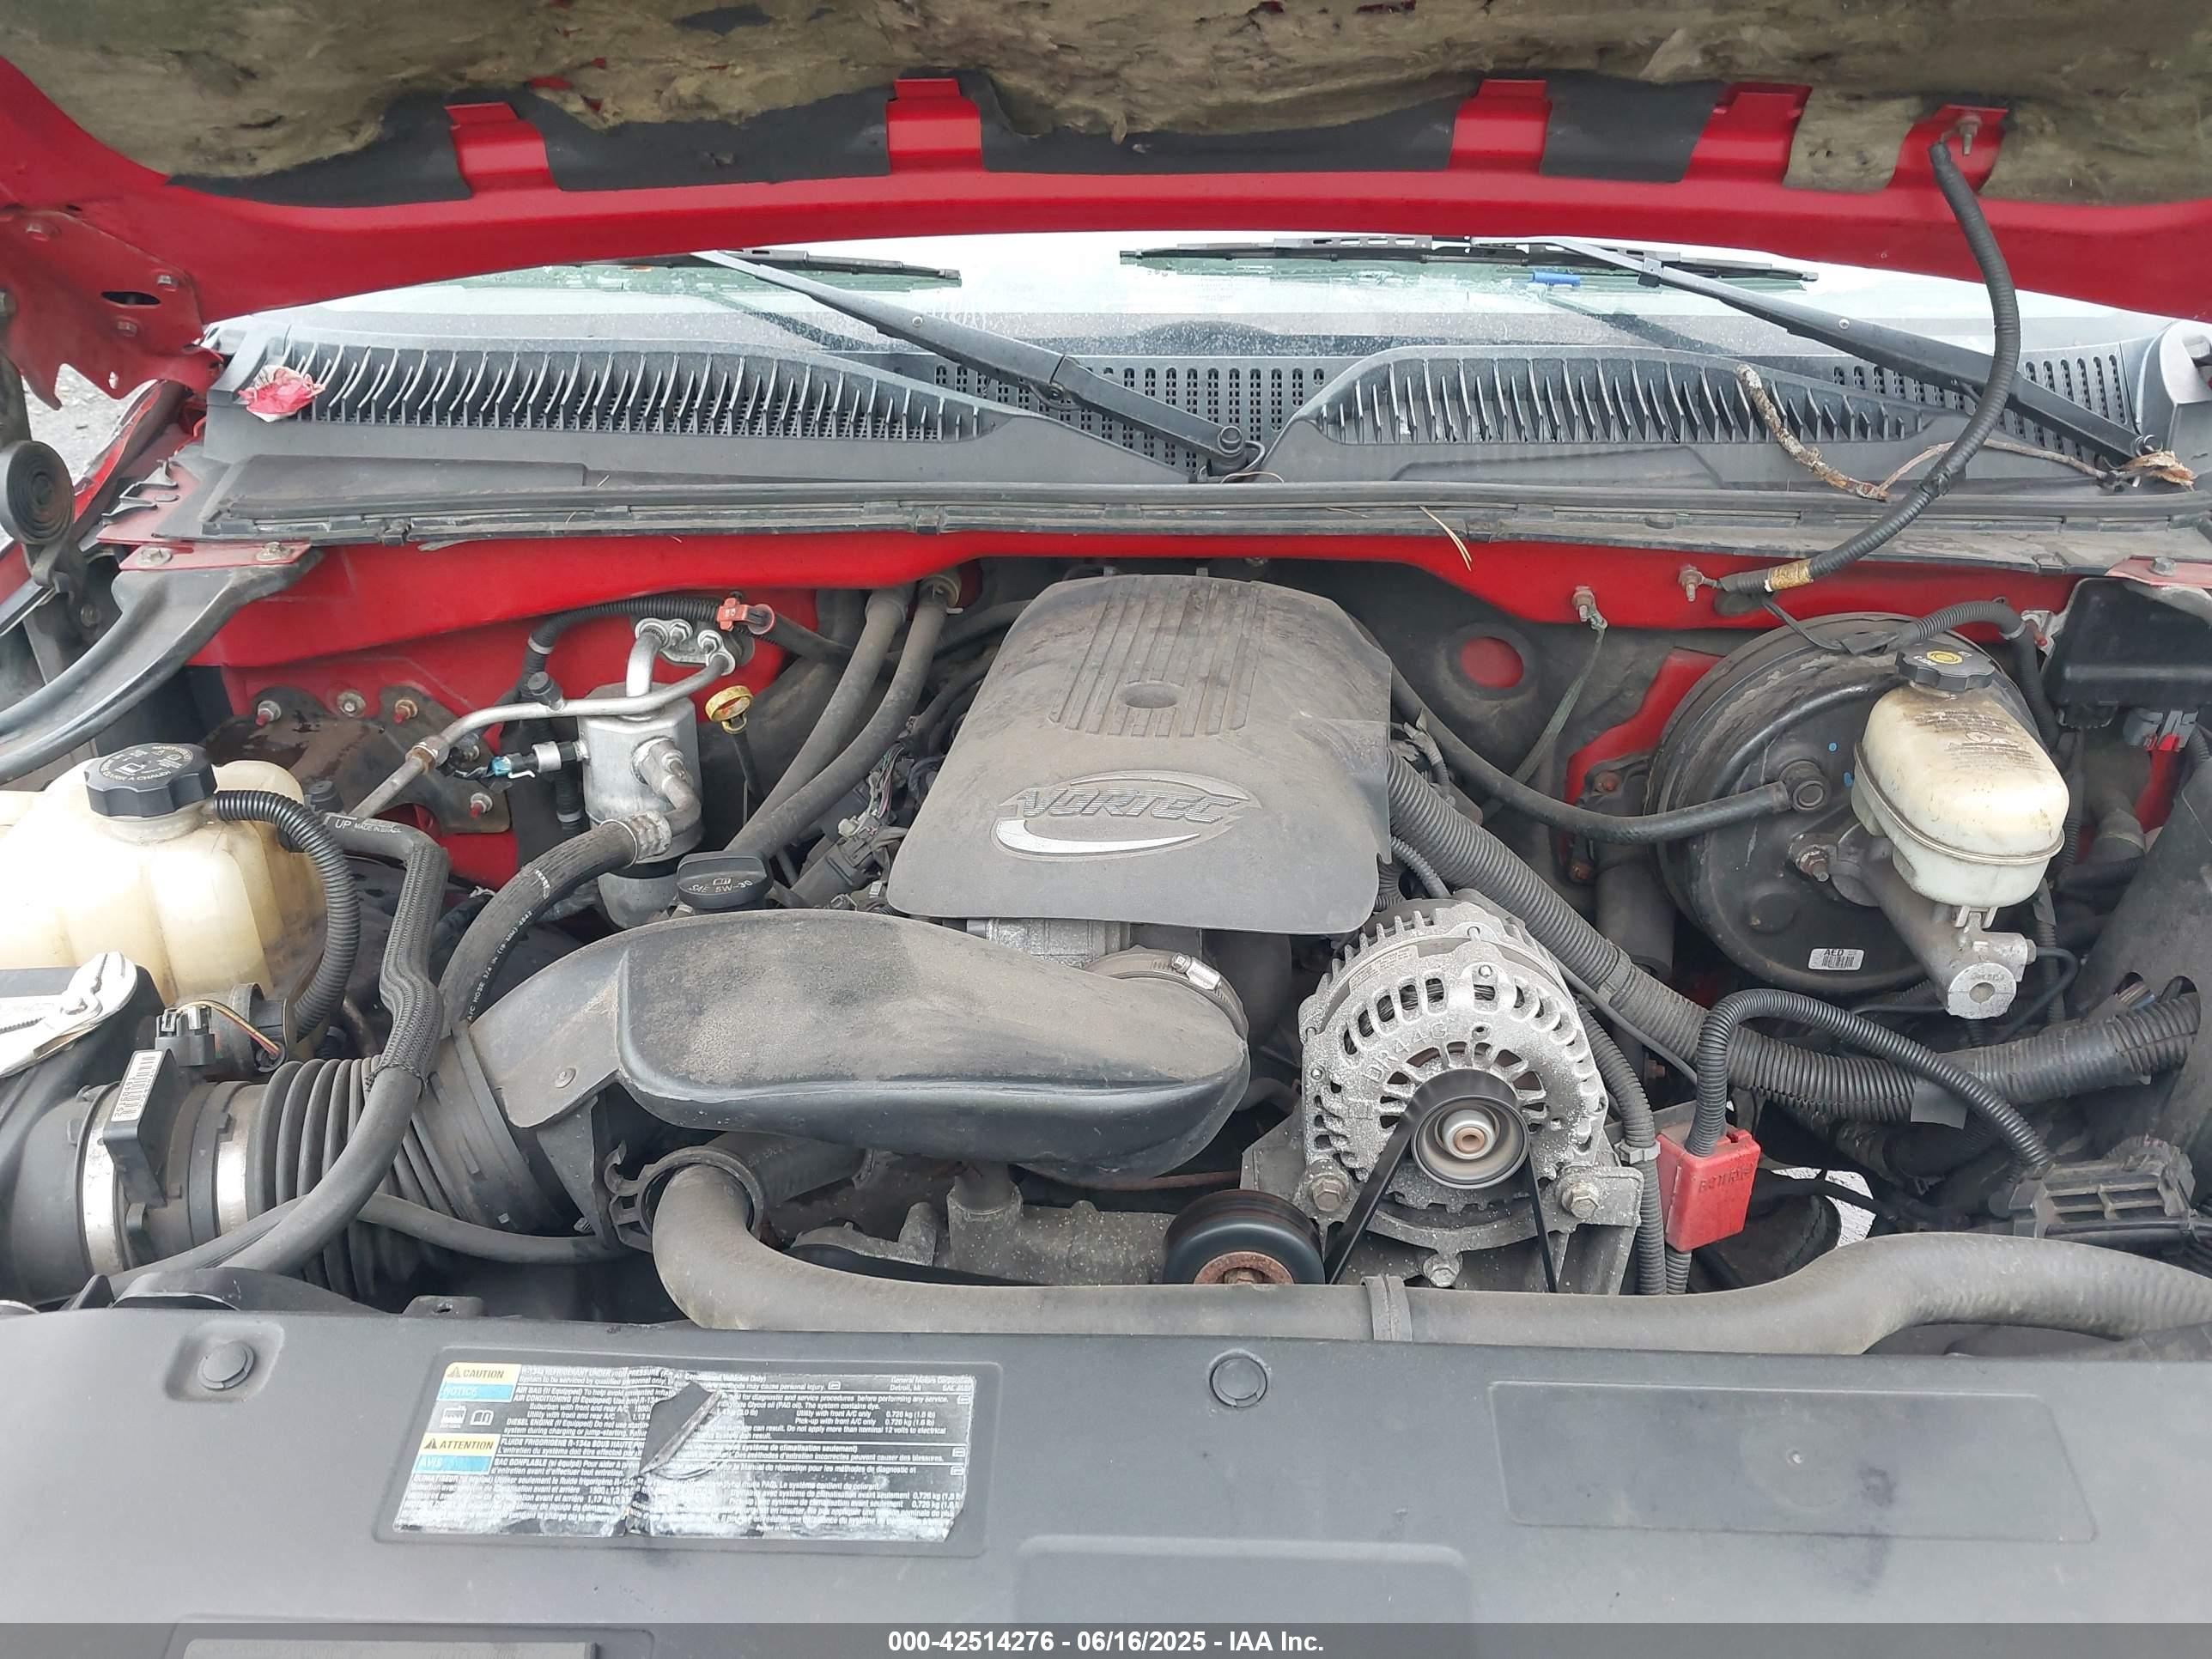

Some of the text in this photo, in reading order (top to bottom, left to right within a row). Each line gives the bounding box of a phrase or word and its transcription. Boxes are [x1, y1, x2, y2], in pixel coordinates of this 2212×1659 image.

[1018, 788, 1241, 824] VORTEC
[335, 818, 351, 829] UP
[354, 823, 373, 831] MADE
[689, 880, 753, 893] SAE 5W-30
[467, 1004, 476, 1021] A/C
[473, 981, 485, 1003] HOSE
[483, 967, 492, 979] 3/4
[490, 957, 498, 965] IN
[464, 1370, 504, 1378] CAUTION
[594, 1378, 621, 1387] qualified
[750, 1375, 766, 1383] Only)
[444, 1387, 477, 1396] NOTICE
[551, 1388, 583, 1396] Equipped)
[592, 1389, 606, 1397] help
[746, 1383, 759, 1392] may
[780, 1383, 805, 1392] personal
[807, 1384, 826, 1393] injury.
[580, 1395, 611, 1405] Equipped)
[626, 1397, 639, 1406] only
[752, 1394, 783, 1402] diagnostic
[820, 1395, 854, 1403] procedures
[878, 1395, 911, 1404] performing
[912, 1395, 923, 1404] any
[747, 1401, 766, 1410] Glycol
[867, 1403, 880, 1412] dye.
[527, 1411, 544, 1419] Utility
[797, 1410, 814, 1419] Utility
[905, 1411, 913, 1419] kg
[563, 1419, 592, 1428] Equipped)
[795, 1418, 818, 1426] Pick-up
[863, 1419, 876, 1427] only
[504, 1427, 526, 1436] system
[549, 1428, 576, 1437] charging
[585, 1429, 628, 1438] jump-starting.
[808, 1425, 824, 1434] apply
[439, 1440, 494, 1450] ATTENTION
[822, 1445, 857, 1454] seulement)
[421, 1457, 443, 1468] AVIS
[851, 1454, 876, 1462] peuvent
[775, 1464, 806, 1473] réparation
[807, 1464, 823, 1473] pour
[876, 1466, 908, 1474] diagnostic
